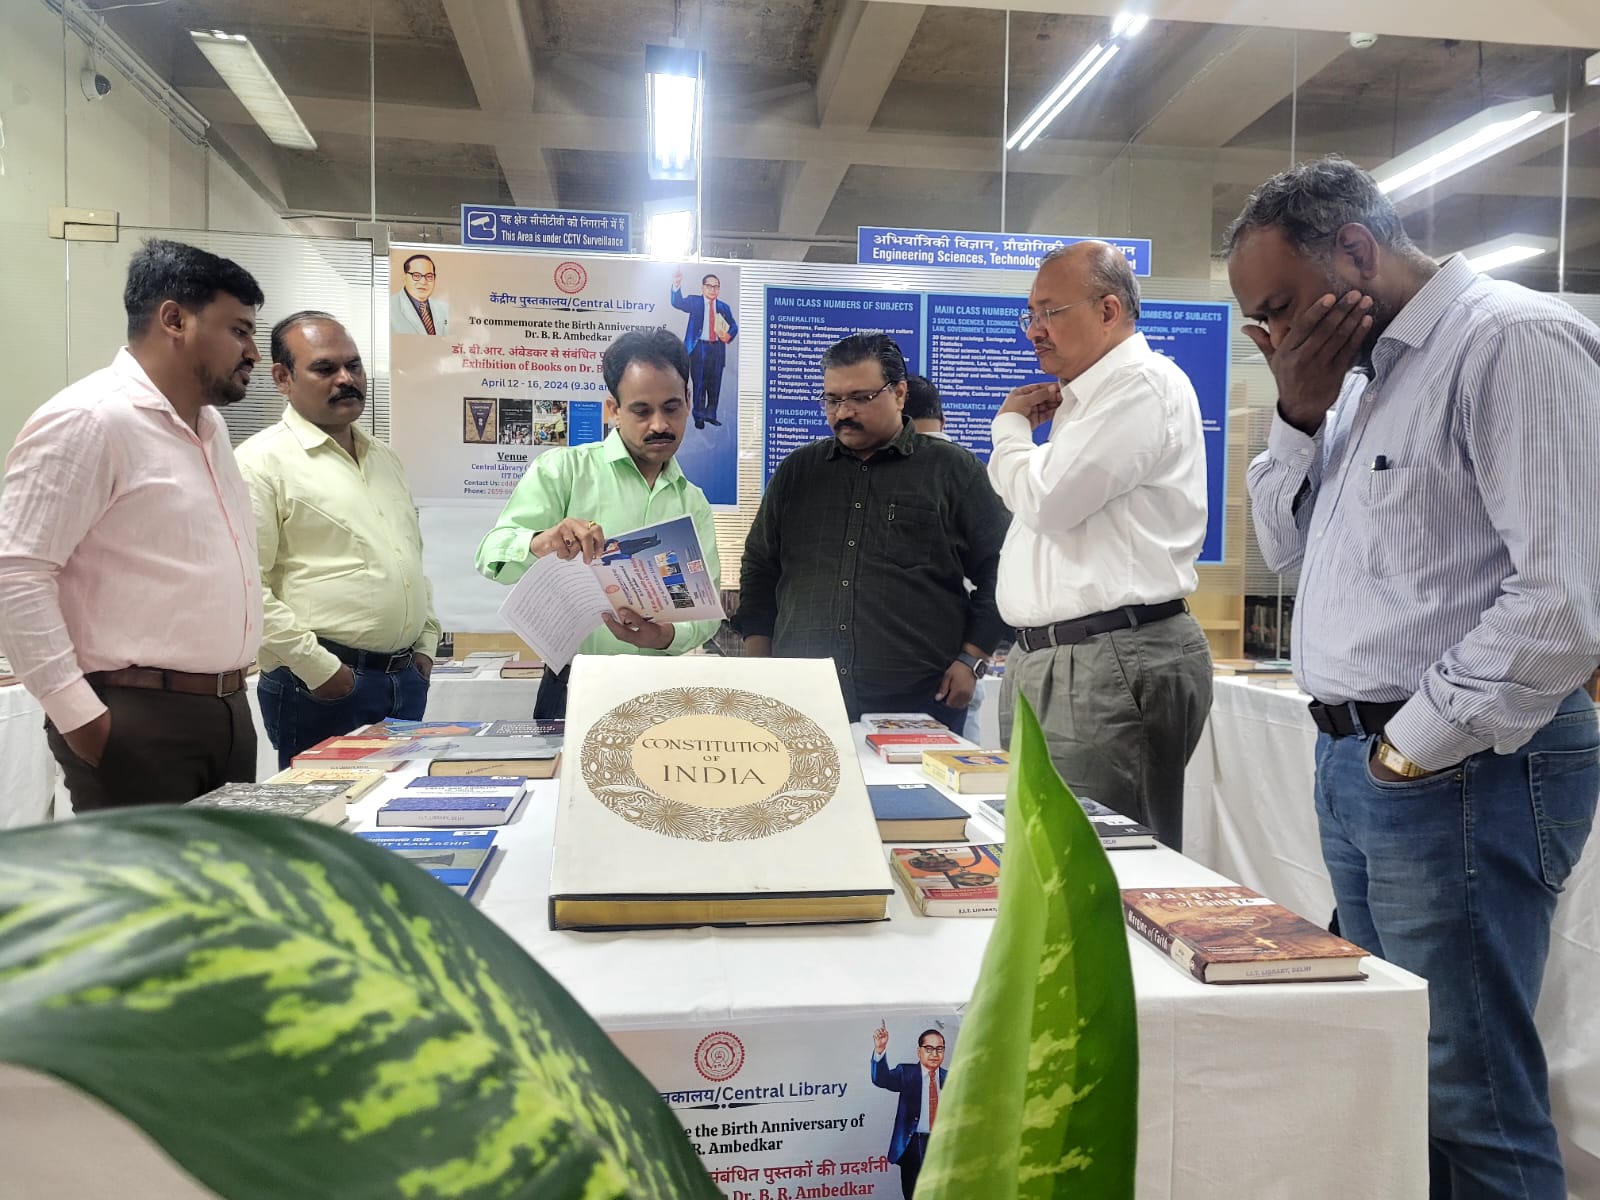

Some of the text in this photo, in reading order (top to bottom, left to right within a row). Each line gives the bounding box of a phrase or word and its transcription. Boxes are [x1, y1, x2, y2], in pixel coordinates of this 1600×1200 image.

[500, 214, 512, 225] यह
[514, 212, 527, 226] क्षेत्र
[530, 213, 564, 227] सीसीटीवी
[567, 216, 578, 228] की
[580, 216, 608, 229] निगरानी
[501, 230, 624, 247] This Area is under CCTV Surveillance
[873, 232, 950, 248] अभियांत्रिकी
[954, 235, 999, 252] विज्ञान,
[873, 247, 1040, 268] Engineering Sciences, Technolog
[490, 292, 655, 312] केंद्रीय पुस्तकालय/Central Library
[774, 297, 914, 311] MAIN CLASS NUMBERS OF SUBJECTS
[935, 305, 1019, 316] MAIN CLASS NUMBERS
[1174, 311, 1184, 319] OF
[1185, 312, 1222, 321] SUBJECTS
[469, 316, 481, 325] To
[483, 318, 553, 328] commemorate
[555, 319, 570, 329] the
[572, 320, 596, 331] Birth
[598, 322, 656, 333] Anniversary
[778, 315, 825, 323] GENERALITIES
[525, 330, 612, 342] Dr. B. R. Ambedkar
[452, 345, 466, 355] डॉ.
[510, 347, 547, 357] अंबेडकर
[551, 348, 559, 358] से
[562, 348, 596, 360] संबंधित
[462, 358, 604, 374] Exhibition of Books on Dr. B
[481, 378, 506, 388] April
[507, 379, 519, 388] 12
[527, 380, 542, 391] 16,
[543, 381, 568, 390] 2024
[570, 381, 597, 392] (9.30
[497, 452, 528, 461] Venue
[498, 464, 524, 472] Library
[642, 738, 779, 753] CONSTITUTION
[664, 765, 766, 784] INDIA
[1143, 892, 1242, 900] Margins
[1178, 898, 1192, 908] of
[1197, 898, 1233, 907] Faith
[1128, 910, 1148, 934] Margins
[1154, 930, 1168, 950] Faith
[790, 1082, 847, 1098] Library
[695, 1125, 717, 1137] the
[722, 1121, 757, 1136] Birth
[760, 1117, 848, 1133] Anniversary
[851, 1114, 865, 1127] of
[709, 1139, 783, 1154] Ambedkar
[764, 1160, 812, 1184] पुस्तकों
[817, 1159, 835, 1175] की
[840, 1155, 888, 1175] प्रदर्शनी
[777, 1187, 793, 1200] R.
[795, 1182, 874, 1199] Ambedkar
